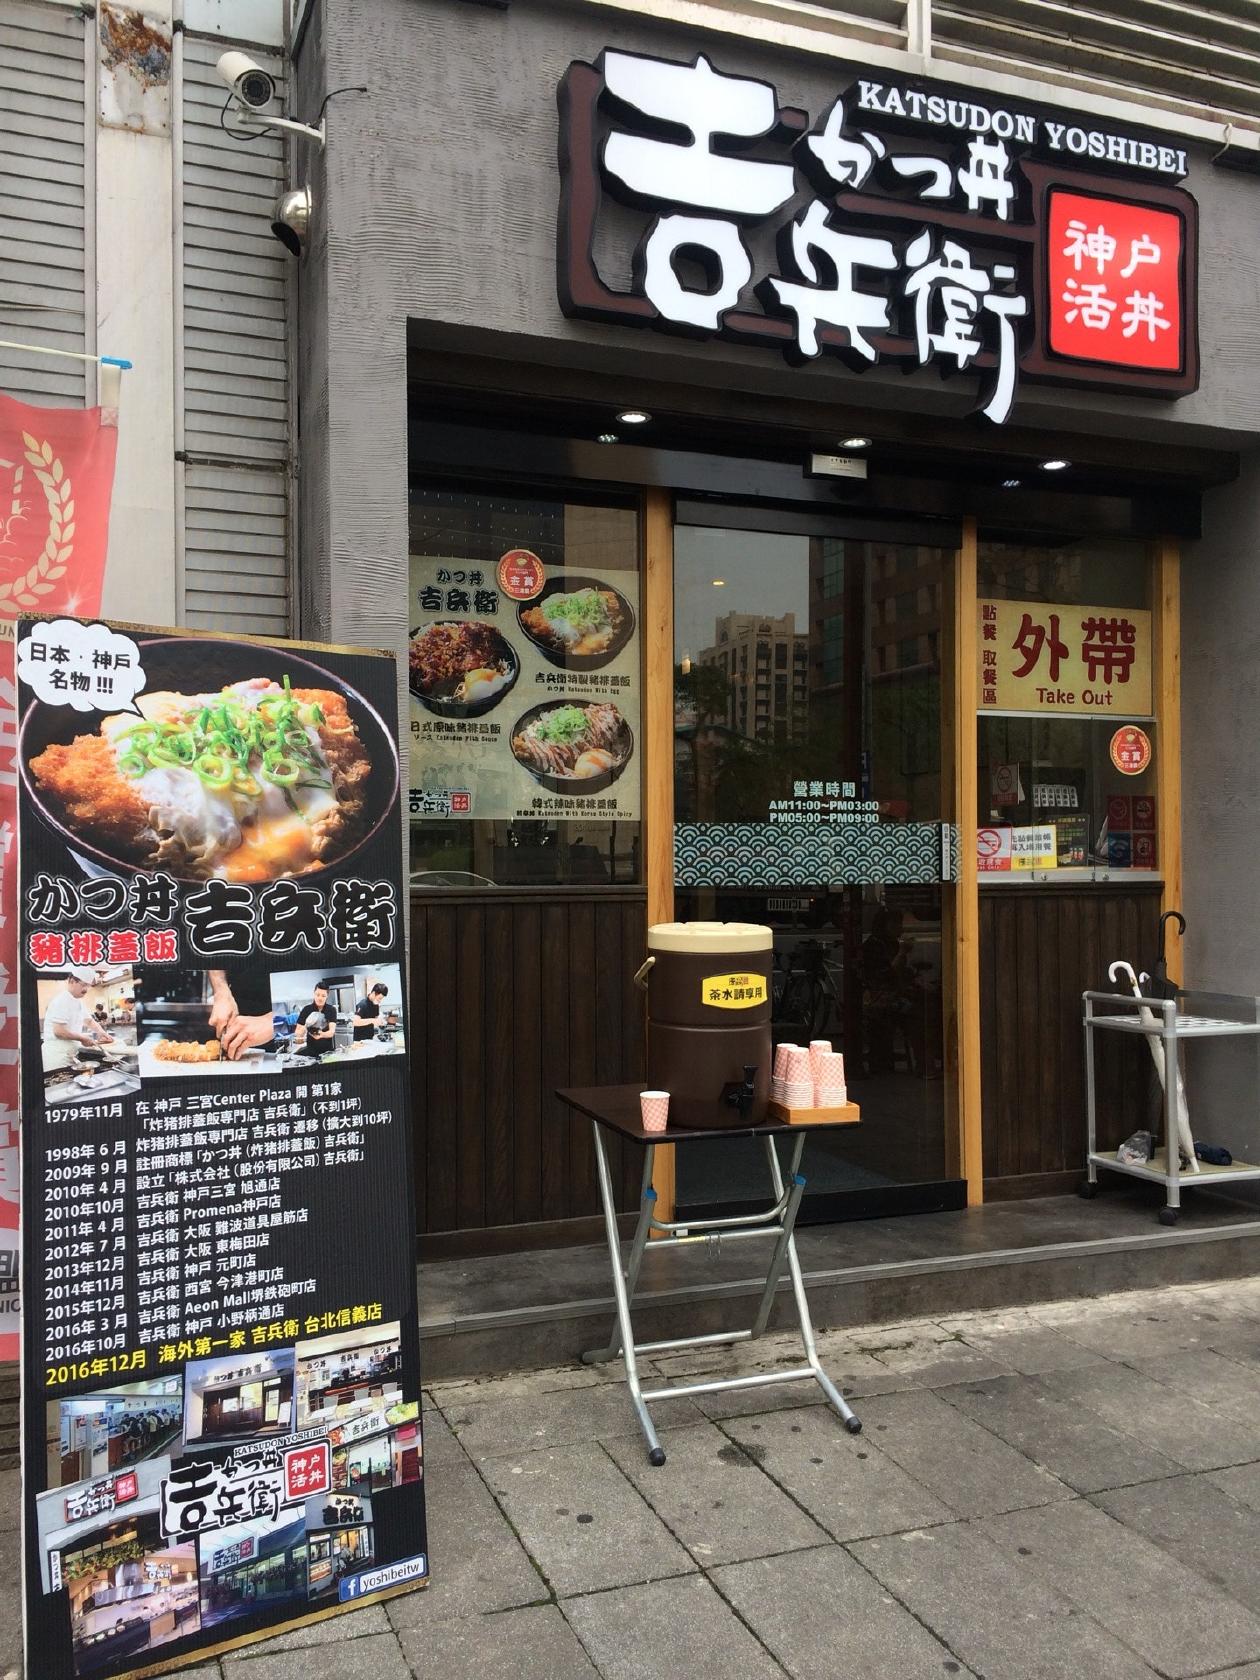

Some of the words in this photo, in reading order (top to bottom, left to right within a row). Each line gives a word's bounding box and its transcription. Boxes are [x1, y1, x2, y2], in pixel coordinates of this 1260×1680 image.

[857, 80, 1036, 144] KATSUDON
[1043, 122, 1188, 176] YOSHIBEI
[808, 100, 1015, 221] かつ丼
[437, 568, 483, 586] かつ丼
[419, 586, 499, 615] 吉兵衛
[1011, 613, 1137, 685] 外帶
[1035, 687, 1075, 705] Take
[1081, 688, 1114, 706] Out
[793, 780, 856, 798] 營業時間
[27, 873, 179, 924] かつ丼
[184, 878, 396, 956] 吉兵衛
[27, 929, 179, 967] 豬排蓋飯
[260, 1087, 291, 1102] Plaza
[137, 1190, 180, 1208] 吉兵衛
[137, 1209, 180, 1228] 吉兵衛
[137, 1229, 180, 1248] 吉兵衛
[184, 1224, 211, 1240] 大阪
[137, 1248, 180, 1267] 吉兵衛
[184, 1242, 211, 1259] 大阪
[216, 1233, 269, 1253] 東梅田店
[137, 1266, 180, 1286] 吉兵衛
[216, 1253, 256, 1272] 元町店
[137, 1286, 180, 1305] 吉兵衛
[184, 1280, 212, 1297] 西宮
[137, 1305, 180, 1324] 吉兵衛
[184, 1297, 219, 1315] Aeon
[46, 1349, 145, 1385] 2016年12月
[158, 1329, 246, 1362] 海外第一家
[251, 1318, 299, 1343] 吉兵衛
[304, 1302, 381, 1333] 台北信義店
[137, 1324, 180, 1344] 吉兵衛
[233, 1437, 285, 1457] KATSUDON
[285, 1426, 328, 1444] YOSHIBEI
[363, 1563, 420, 1593] yoshibeitw
